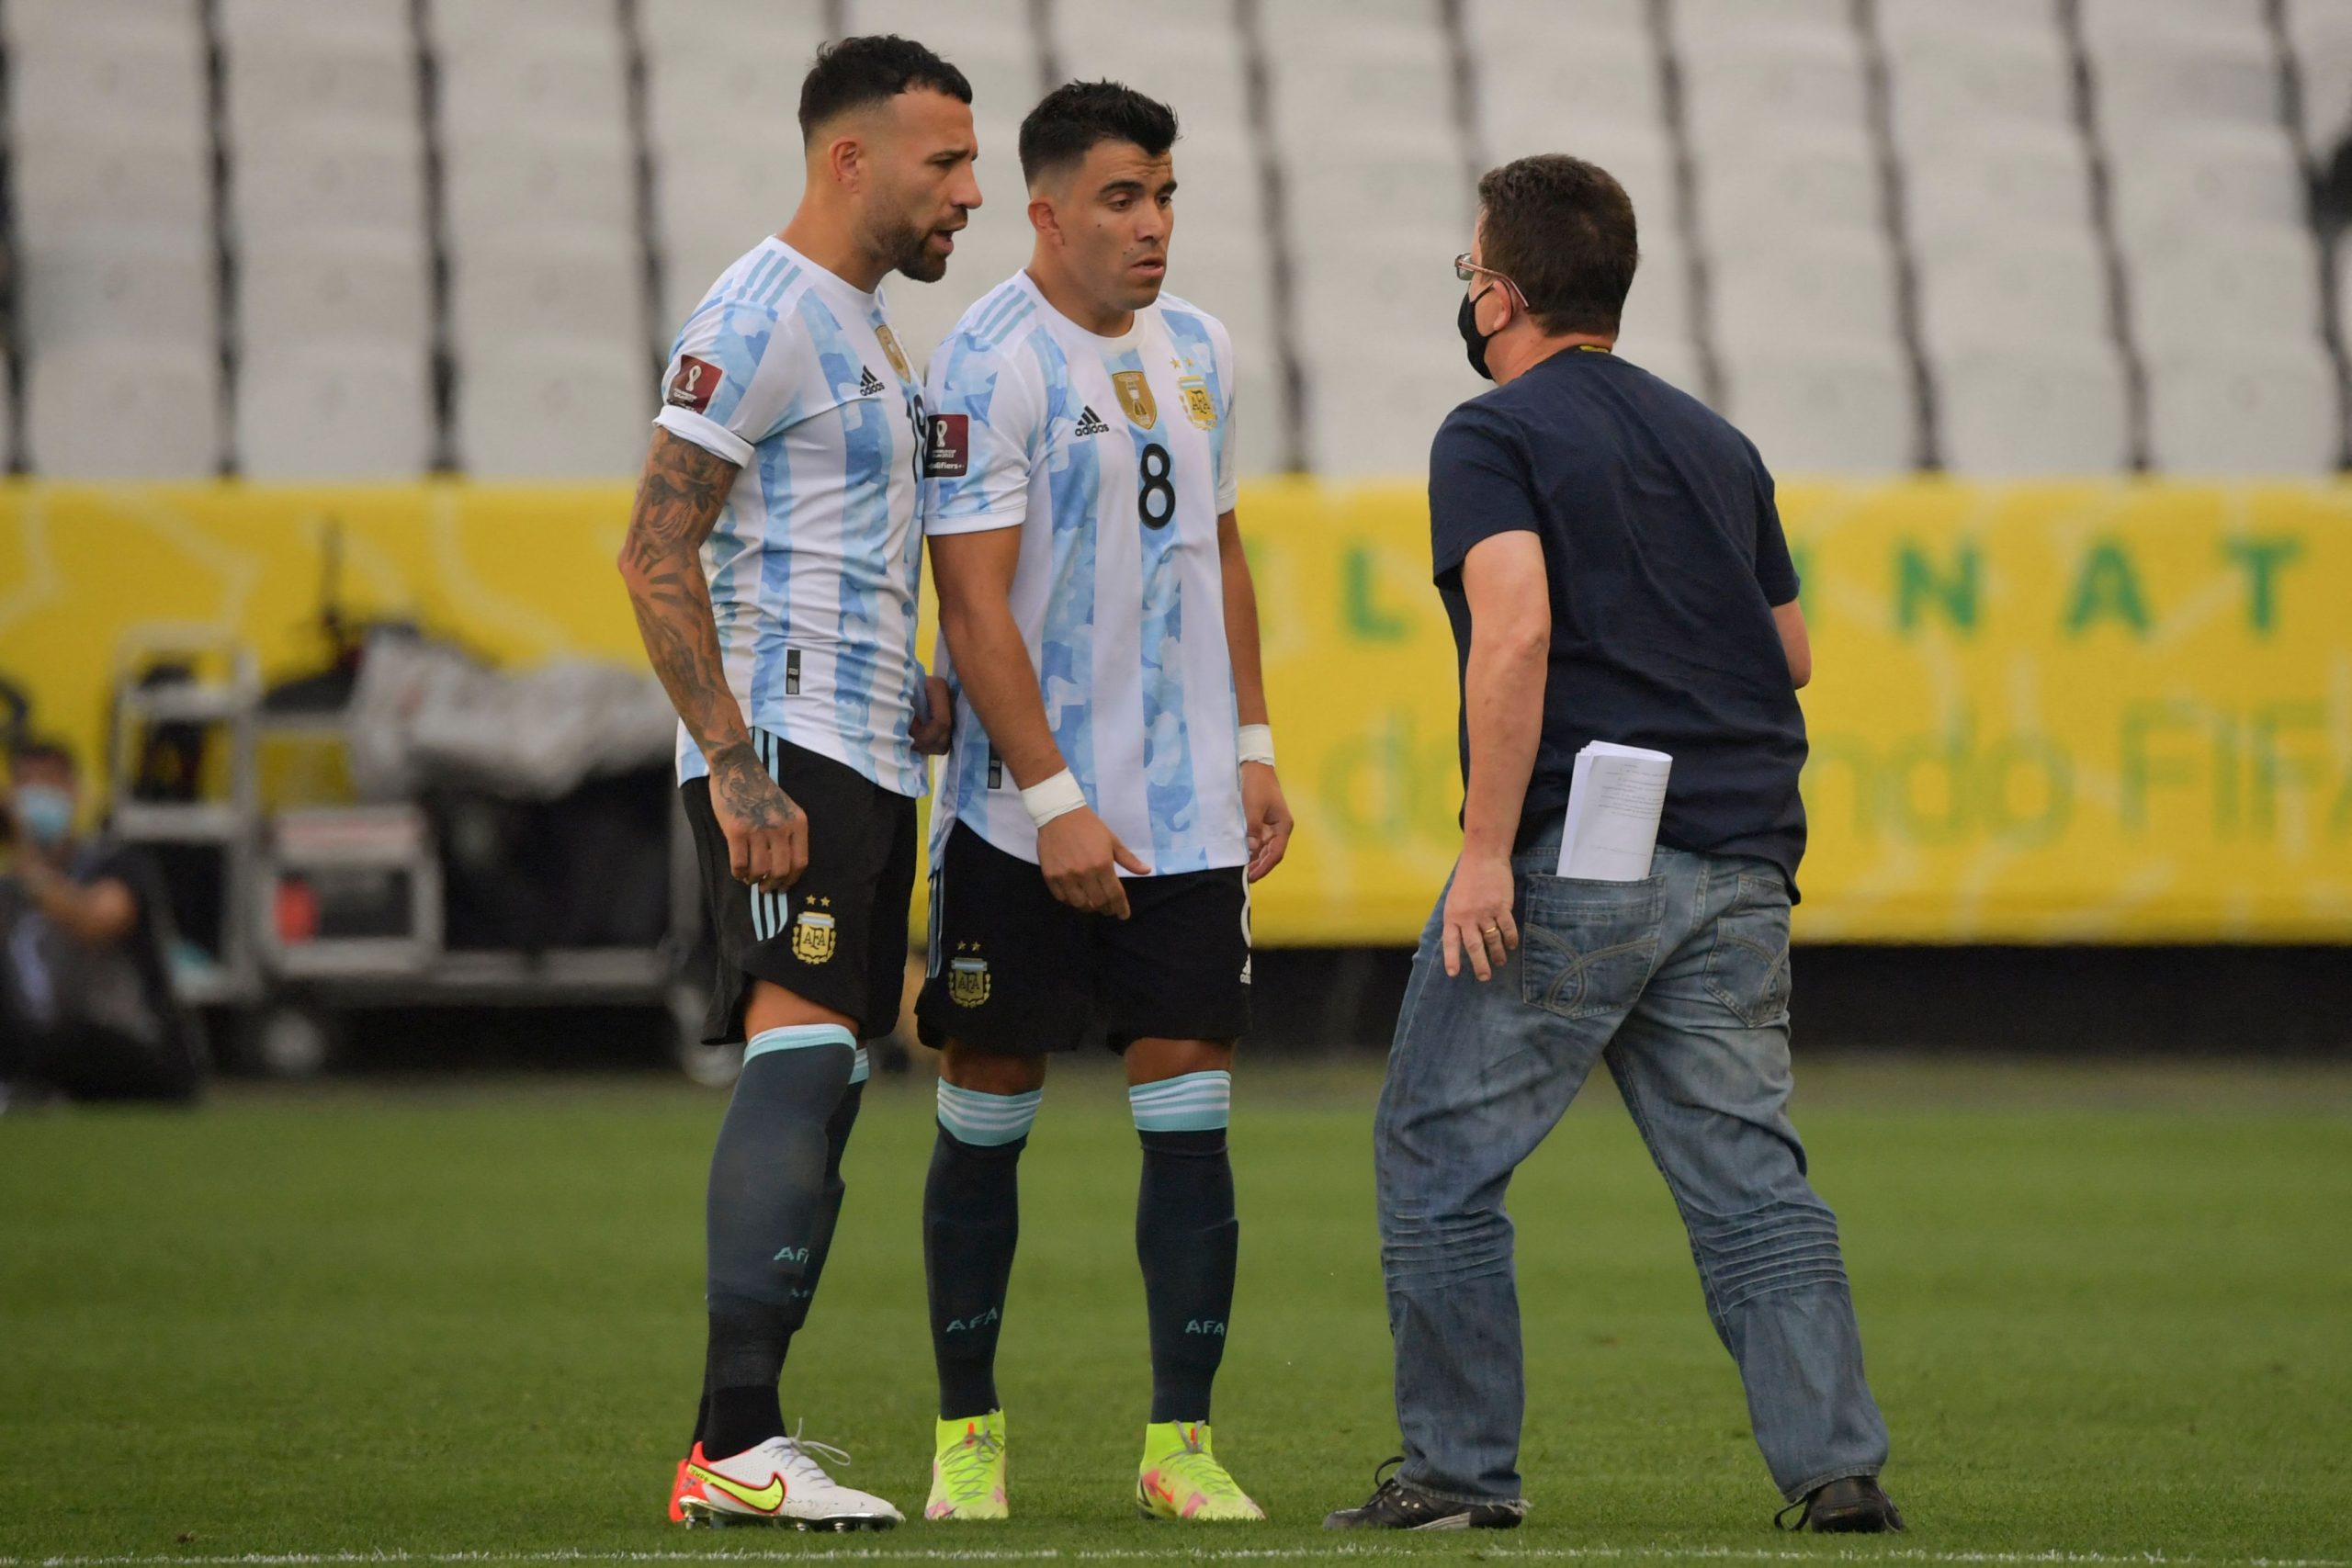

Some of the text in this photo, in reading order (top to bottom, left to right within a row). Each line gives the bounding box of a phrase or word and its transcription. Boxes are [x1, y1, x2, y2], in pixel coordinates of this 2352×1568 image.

[860, 382, 885, 396] adidas
[1075, 423, 1109, 436] adidas
[1138, 443, 1176, 530] 8
[803, 927, 825, 950] AFA
[773, 1247, 809, 1264] AF
[946, 1306, 998, 1333] AFA
[1185, 1319, 1225, 1337] AFA
